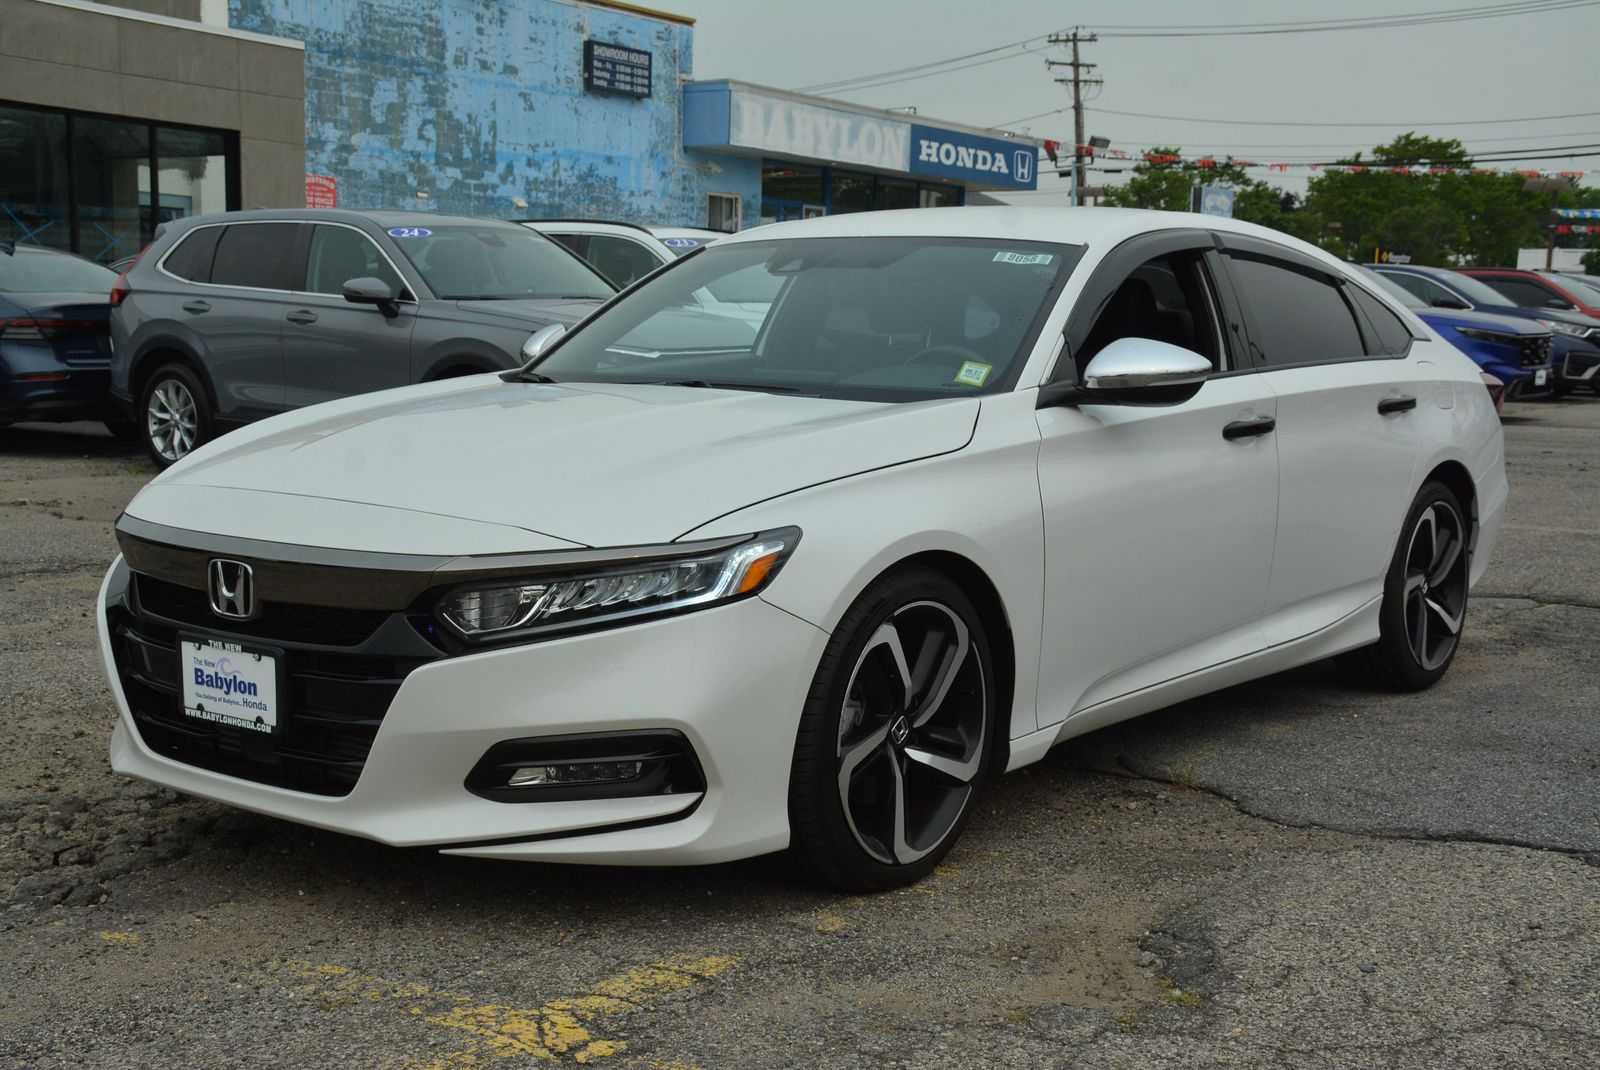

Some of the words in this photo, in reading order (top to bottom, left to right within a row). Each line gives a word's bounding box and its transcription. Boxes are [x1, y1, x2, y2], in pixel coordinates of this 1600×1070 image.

[593, 45, 629, 60] SHOWROOM
[629, 52, 649, 66] HOURS
[739, 98, 907, 170] BABYLON
[919, 139, 1009, 174] HONDA
[401, 228, 419, 237] 24
[1007, 253, 1038, 263] 8058
[208, 639, 223, 650] THE
[224, 643, 242, 653] NEW
[193, 656, 203, 666] The
[204, 658, 216, 668] New
[194, 667, 258, 697] Babylon
[242, 698, 268, 711] Honda
[185, 708, 272, 733] WWW.BABYLONHONDA.COM
